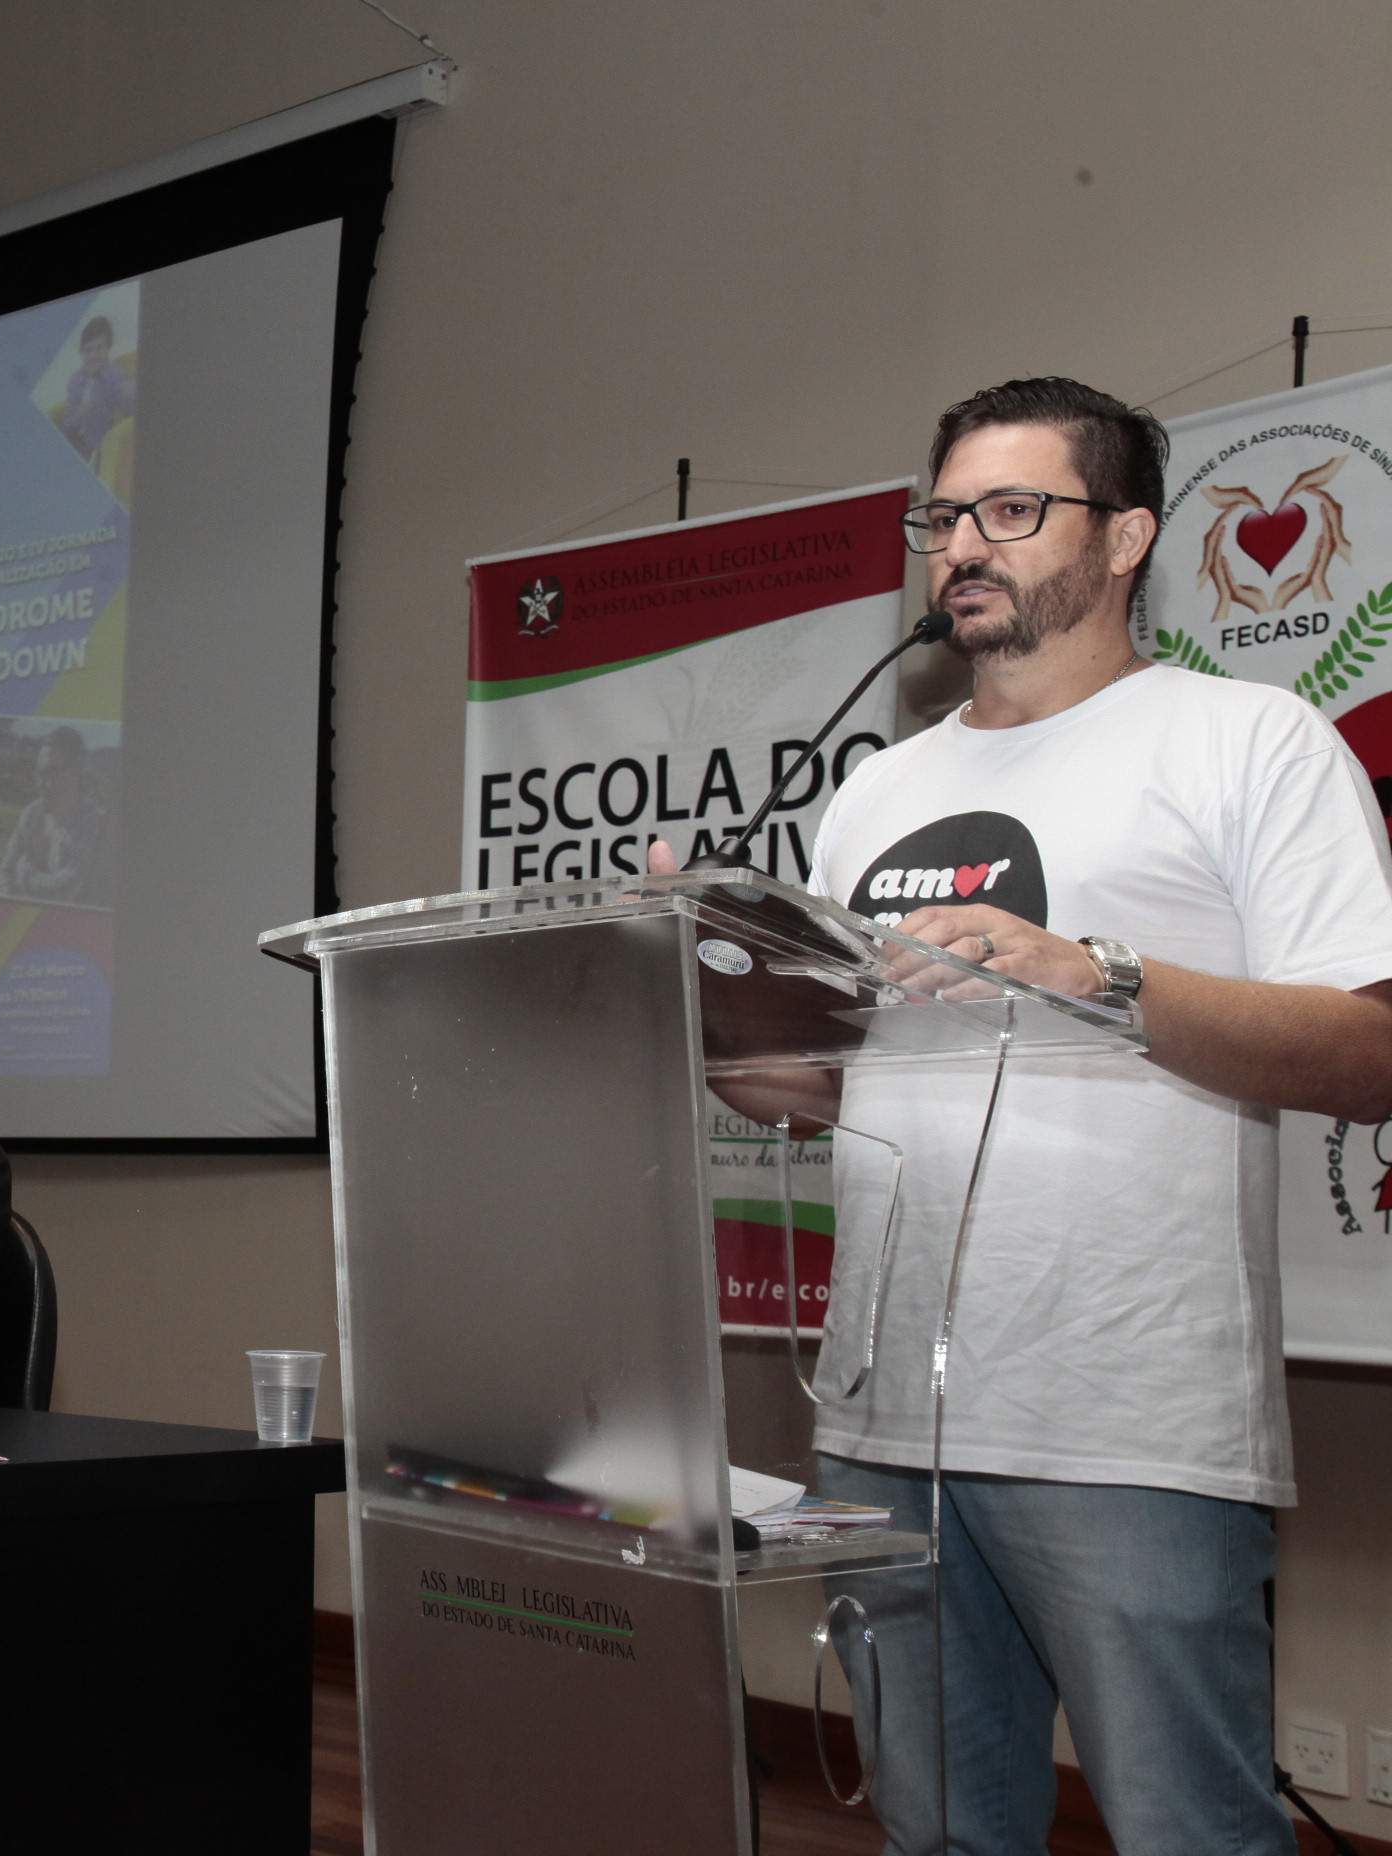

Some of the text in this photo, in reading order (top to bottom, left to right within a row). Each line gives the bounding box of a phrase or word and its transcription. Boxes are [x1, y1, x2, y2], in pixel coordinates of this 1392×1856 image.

[1218, 440, 1246, 462] DAS
[1250, 424, 1350, 446] ASSOCIAÇÕES
[1351, 435, 1371, 453] DE
[571, 562, 852, 621] DO ESTADO DE SANTA CATARINA
[574, 530, 852, 595] ASSEMBLEIA LEGISLATIVA
[1221, 612, 1329, 650] FECASD
[479, 747, 743, 839] ESCOLA
[423, 1602, 635, 1661] DO ESTADO DE SANTA CATARINA
[522, 1588, 633, 1631] LEGISLATIVA
